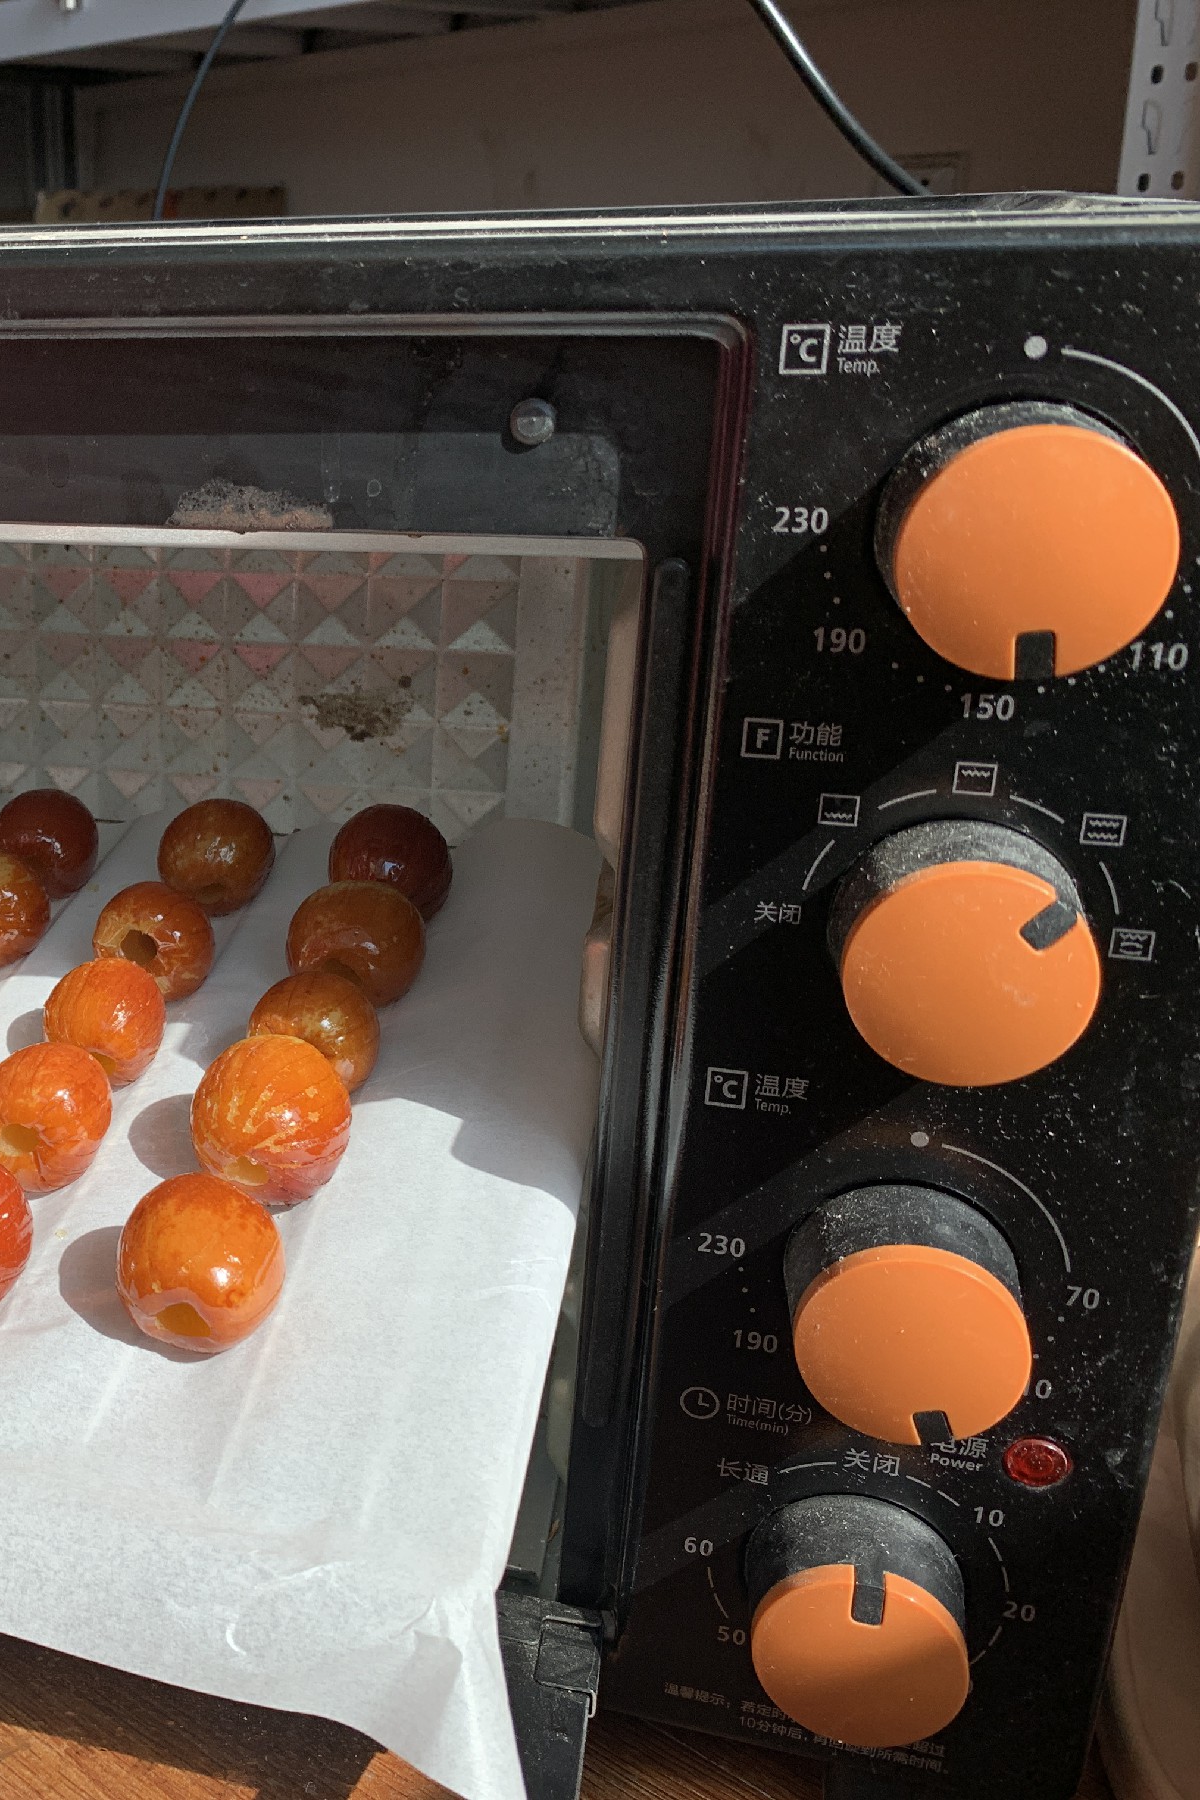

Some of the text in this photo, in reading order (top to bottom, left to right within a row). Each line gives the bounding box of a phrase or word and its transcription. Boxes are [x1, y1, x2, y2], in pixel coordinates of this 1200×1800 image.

[837, 325, 900, 353] 温度
[772, 507, 828, 533] 230
[813, 627, 865, 653] 190
[1129, 642, 1188, 671] 110
[960, 694, 1015, 721] 150
[756, 728, 770, 749] F
[789, 722, 842, 747] 功能
[788, 747, 844, 763] Function
[754, 901, 801, 924] 关闭
[755, 1073, 810, 1100] 温度
[755, 1098, 792, 1115] Temp.
[697, 1233, 746, 1258] 230
[1065, 1286, 1099, 1309] 70
[733, 1329, 778, 1353] 190
[726, 1393, 813, 1424] 时间(分)
[726, 1414, 789, 1436] Time(min)
[716, 1457, 769, 1485] 长通
[844, 1449, 900, 1478] 关闭
[930, 1453, 984, 1472] Power
[972, 1506, 1004, 1528] 10
[684, 1537, 714, 1557] 60
[1002, 1602, 1036, 1622] 20
[716, 1626, 746, 1646] 50
